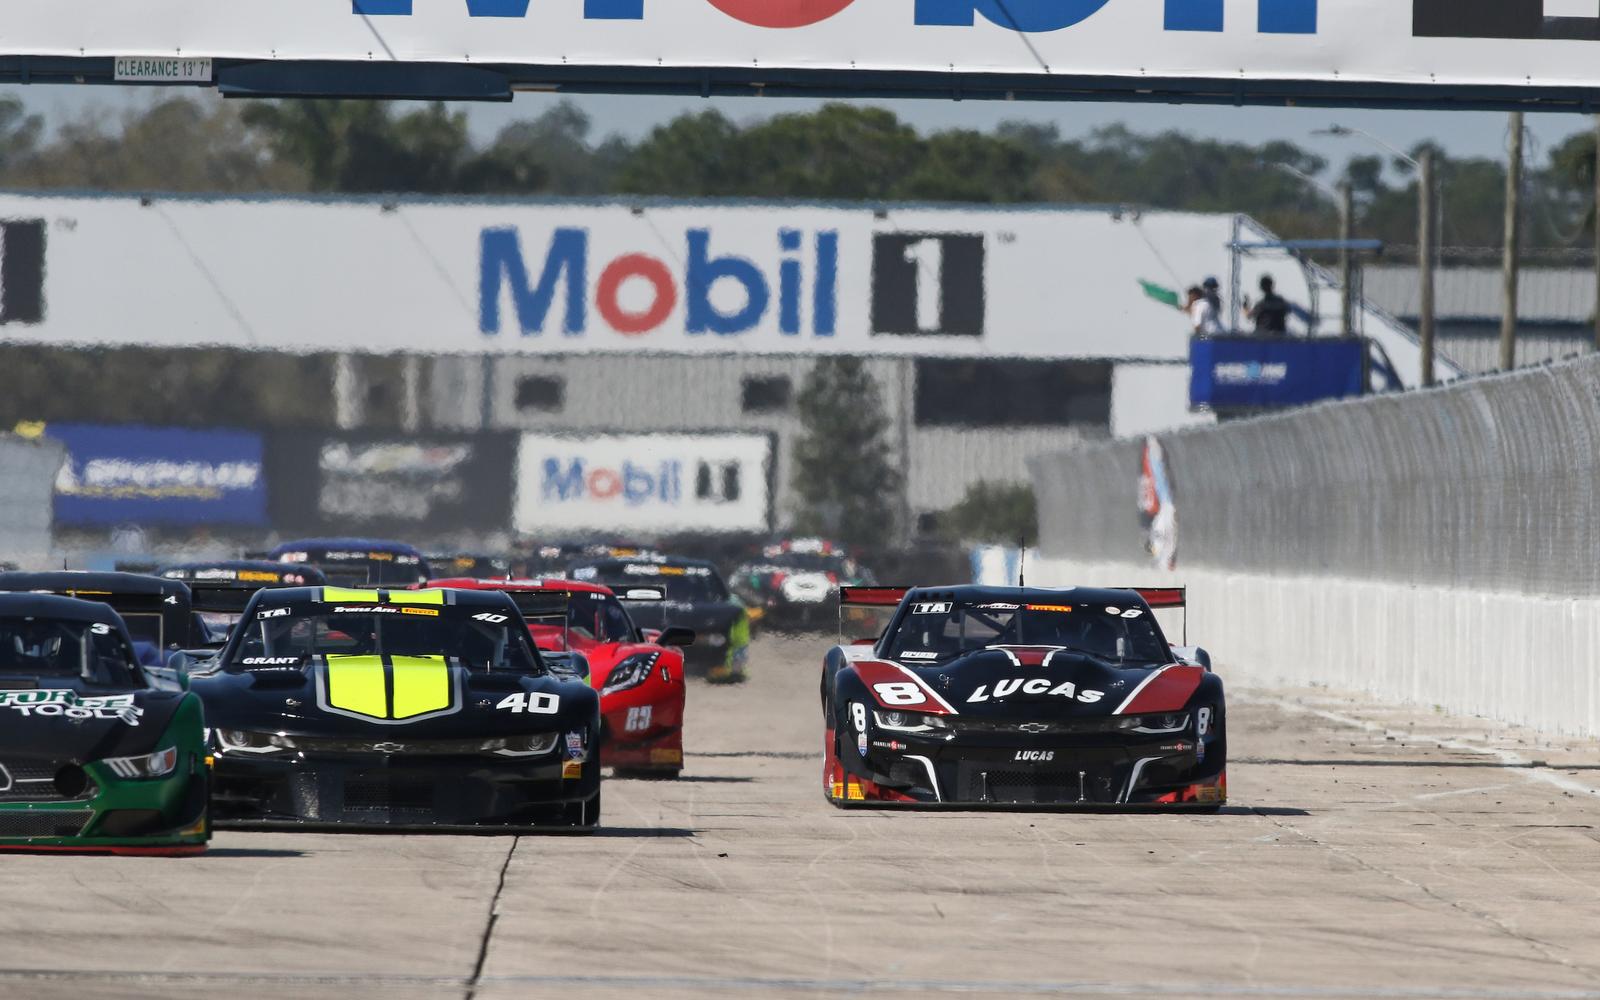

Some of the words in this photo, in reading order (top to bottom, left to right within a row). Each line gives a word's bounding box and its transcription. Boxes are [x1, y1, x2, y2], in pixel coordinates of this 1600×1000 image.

[117, 61, 178, 76] CLEARANCE
[182, 62, 196, 76] 13'
[199, 62, 210, 76] 7"
[479, 226, 838, 337] Mobil
[903, 238, 943, 331] 1
[542, 457, 682, 503] Mobil
[164, 595, 178, 605] 4
[919, 602, 947, 613] TA
[261, 608, 287, 618] TA
[472, 613, 508, 623] 40
[1120, 609, 1143, 618] 8
[91, 623, 110, 635] 3
[873, 682, 926, 705] 8
[966, 679, 1104, 703] LUCAS
[496, 692, 560, 714] 40
[10, 704, 144, 726] TOOLS
[852, 702, 866, 733] 8
[1198, 707, 1211, 735] 8
[1015, 751, 1054, 761] LUCAS
